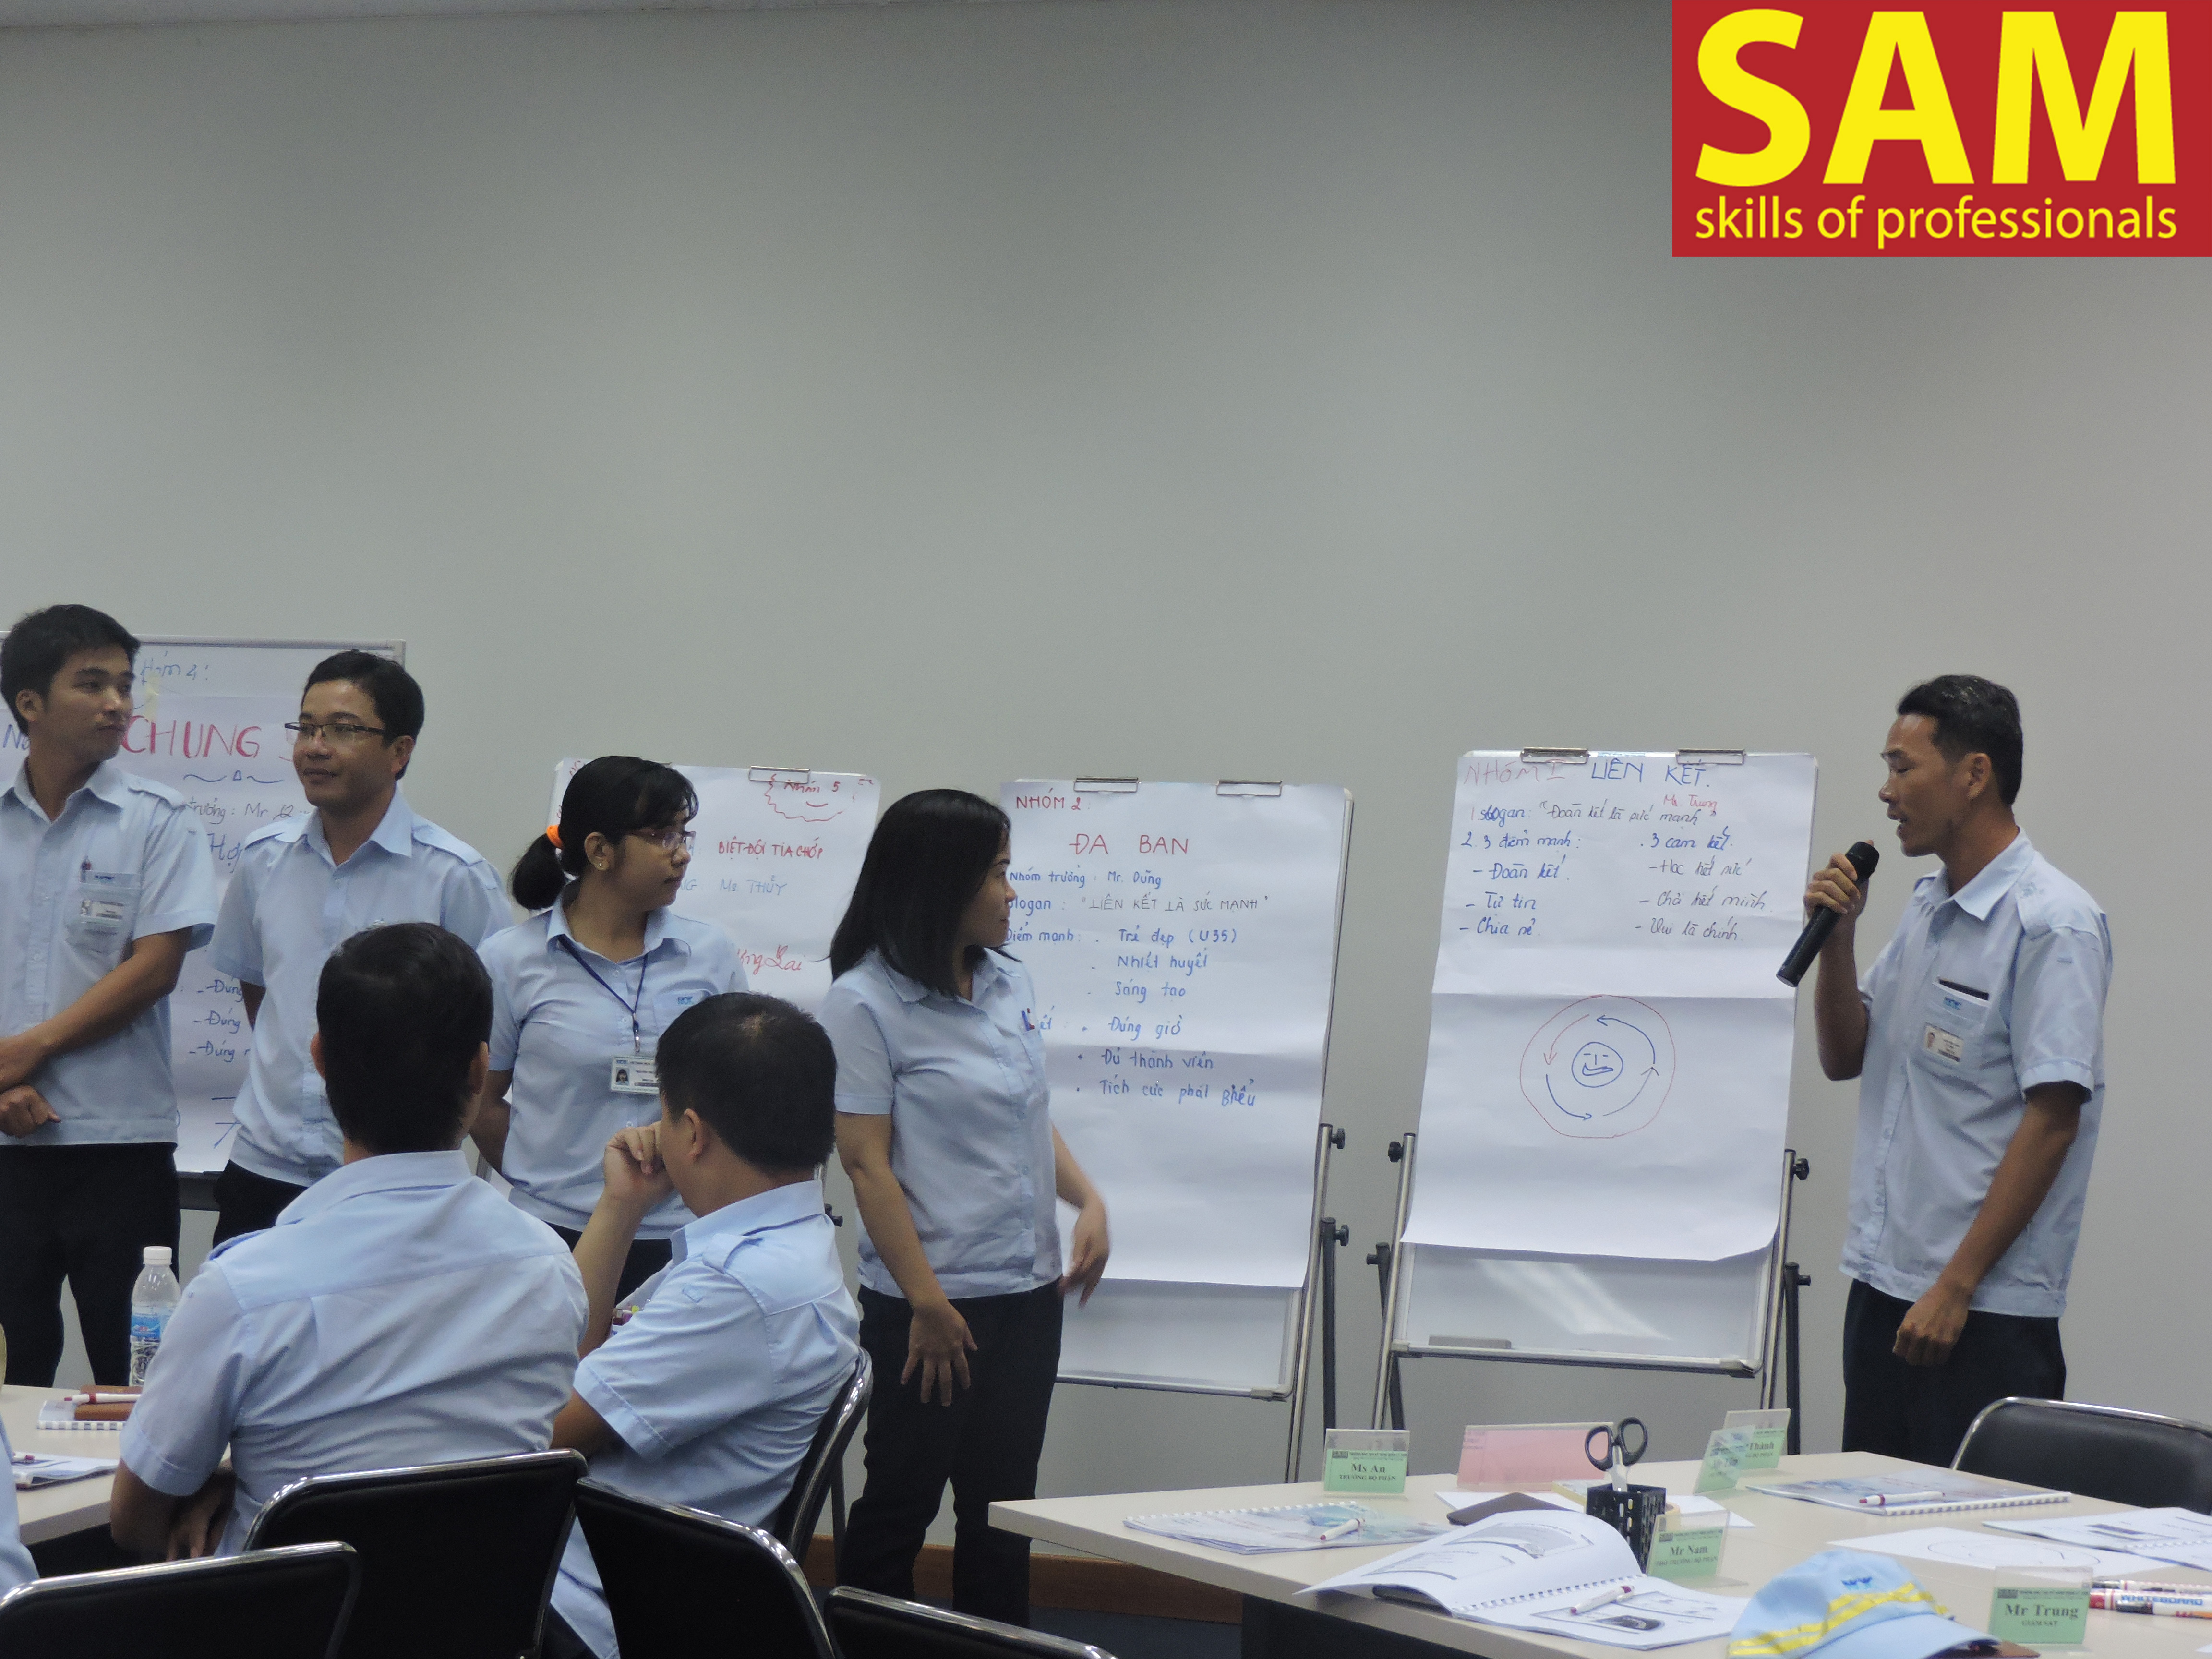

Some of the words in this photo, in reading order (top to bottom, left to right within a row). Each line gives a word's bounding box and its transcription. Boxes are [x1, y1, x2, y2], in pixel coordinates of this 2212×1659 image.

[120, 715, 262, 758] CHUNG
[1464, 761, 1539, 784] NHÓM
[1591, 757, 1643, 782] LIÊN
[832, 781, 840, 792] 5
[1016, 788, 1064, 808] NHÓM
[245, 802, 268, 817] Mr
[1069, 833, 1109, 855] ĐA
[1139, 834, 1189, 854] BAN
[1483, 835, 1491, 849] 3
[1650, 832, 1659, 848] 3
[1665, 837, 1696, 848] cam
[1010, 867, 1041, 881] Nhóm
[720, 879, 737, 891] Ms
[1512, 893, 1536, 910] tin
[1477, 916, 1509, 934] Chia
[1351, 1463, 1367, 1472] Ms
[1371, 1465, 1385, 1473] An
[1687, 1544, 1708, 1554] Nam
[2006, 1604, 2029, 1616] Mr
[2034, 1604, 2079, 1620] Trung
